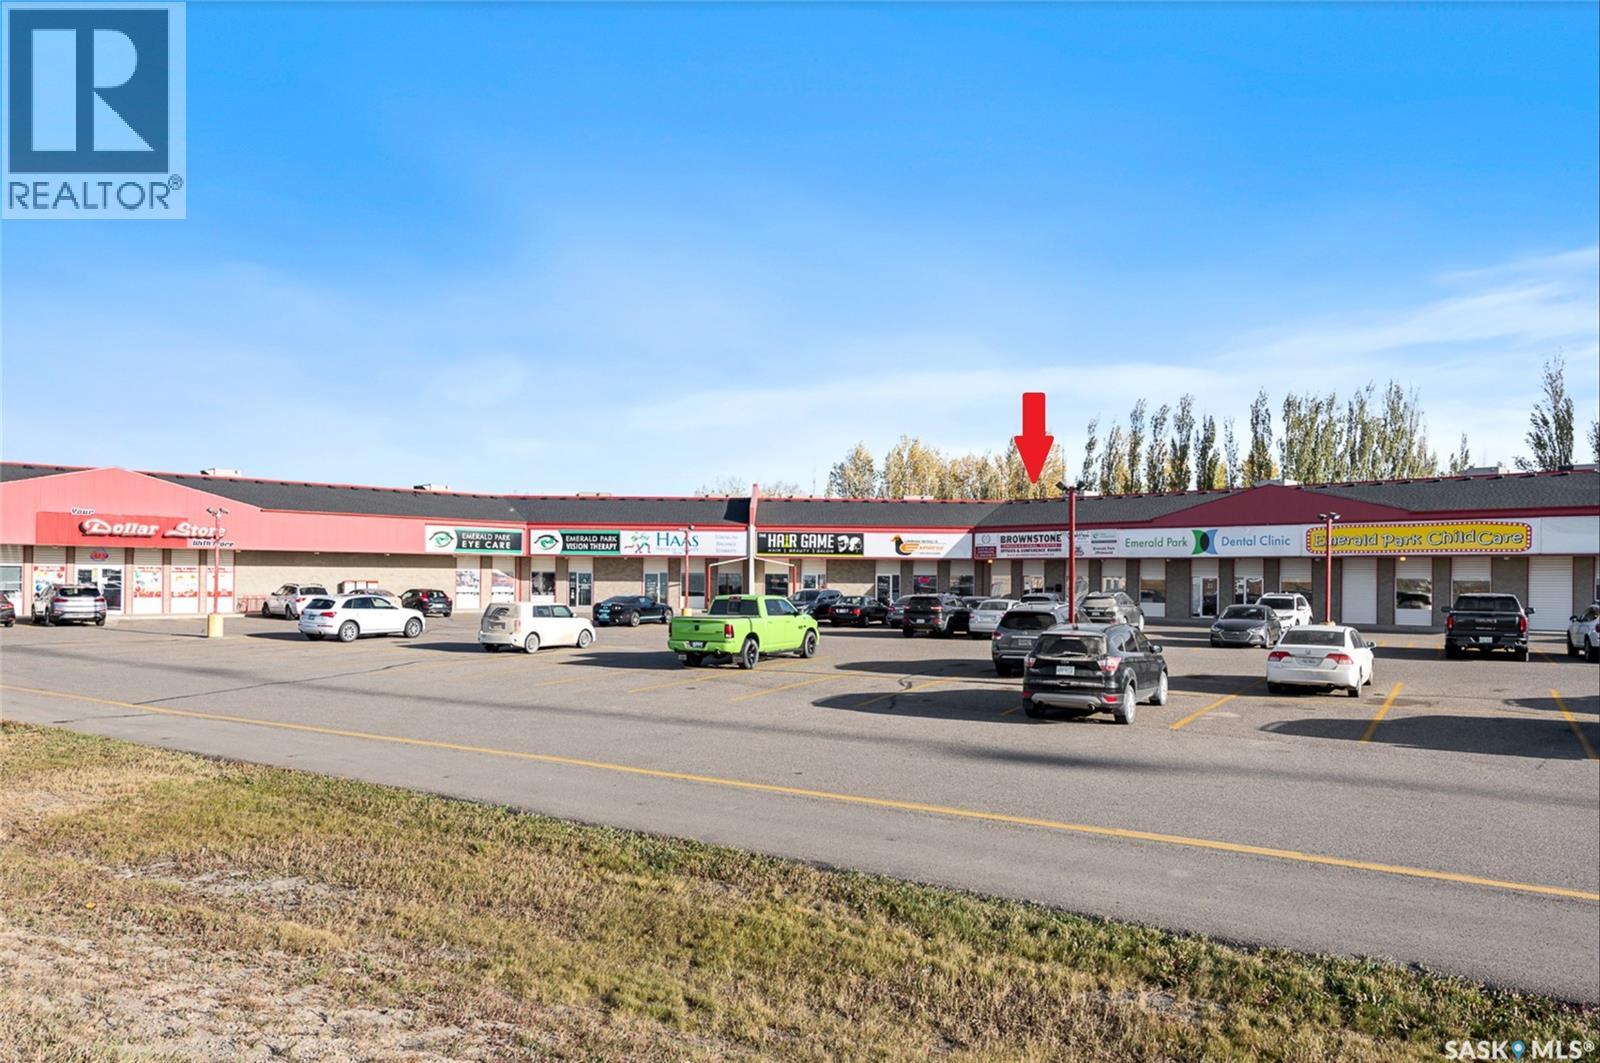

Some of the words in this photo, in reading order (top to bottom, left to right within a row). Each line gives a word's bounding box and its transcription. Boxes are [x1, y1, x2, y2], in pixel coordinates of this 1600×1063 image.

[71, 507, 95, 516] Your
[79, 518, 160, 538] Dollar
[161, 521, 226, 540] Store
[461, 532, 492, 541] EMERALD
[494, 533, 511, 541] PARK
[565, 534, 597, 543] EMERALD
[599, 533, 618, 543] PARK
[767, 533, 798, 548] HAIR
[801, 534, 835, 549] GAME
[1000, 533, 1062, 544] BROWNSTONE
[1383, 533, 1422, 548] Park
[461, 540, 480, 549] EYE
[485, 541, 511, 550] CARE
[565, 542, 588, 551] VISION
[590, 542, 618, 551] THERAPY
[1125, 537, 1164, 549] Emerald
[1166, 537, 1188, 548] Park
[1221, 535, 1256, 547] Dental
[1259, 535, 1291, 547] Clinic
